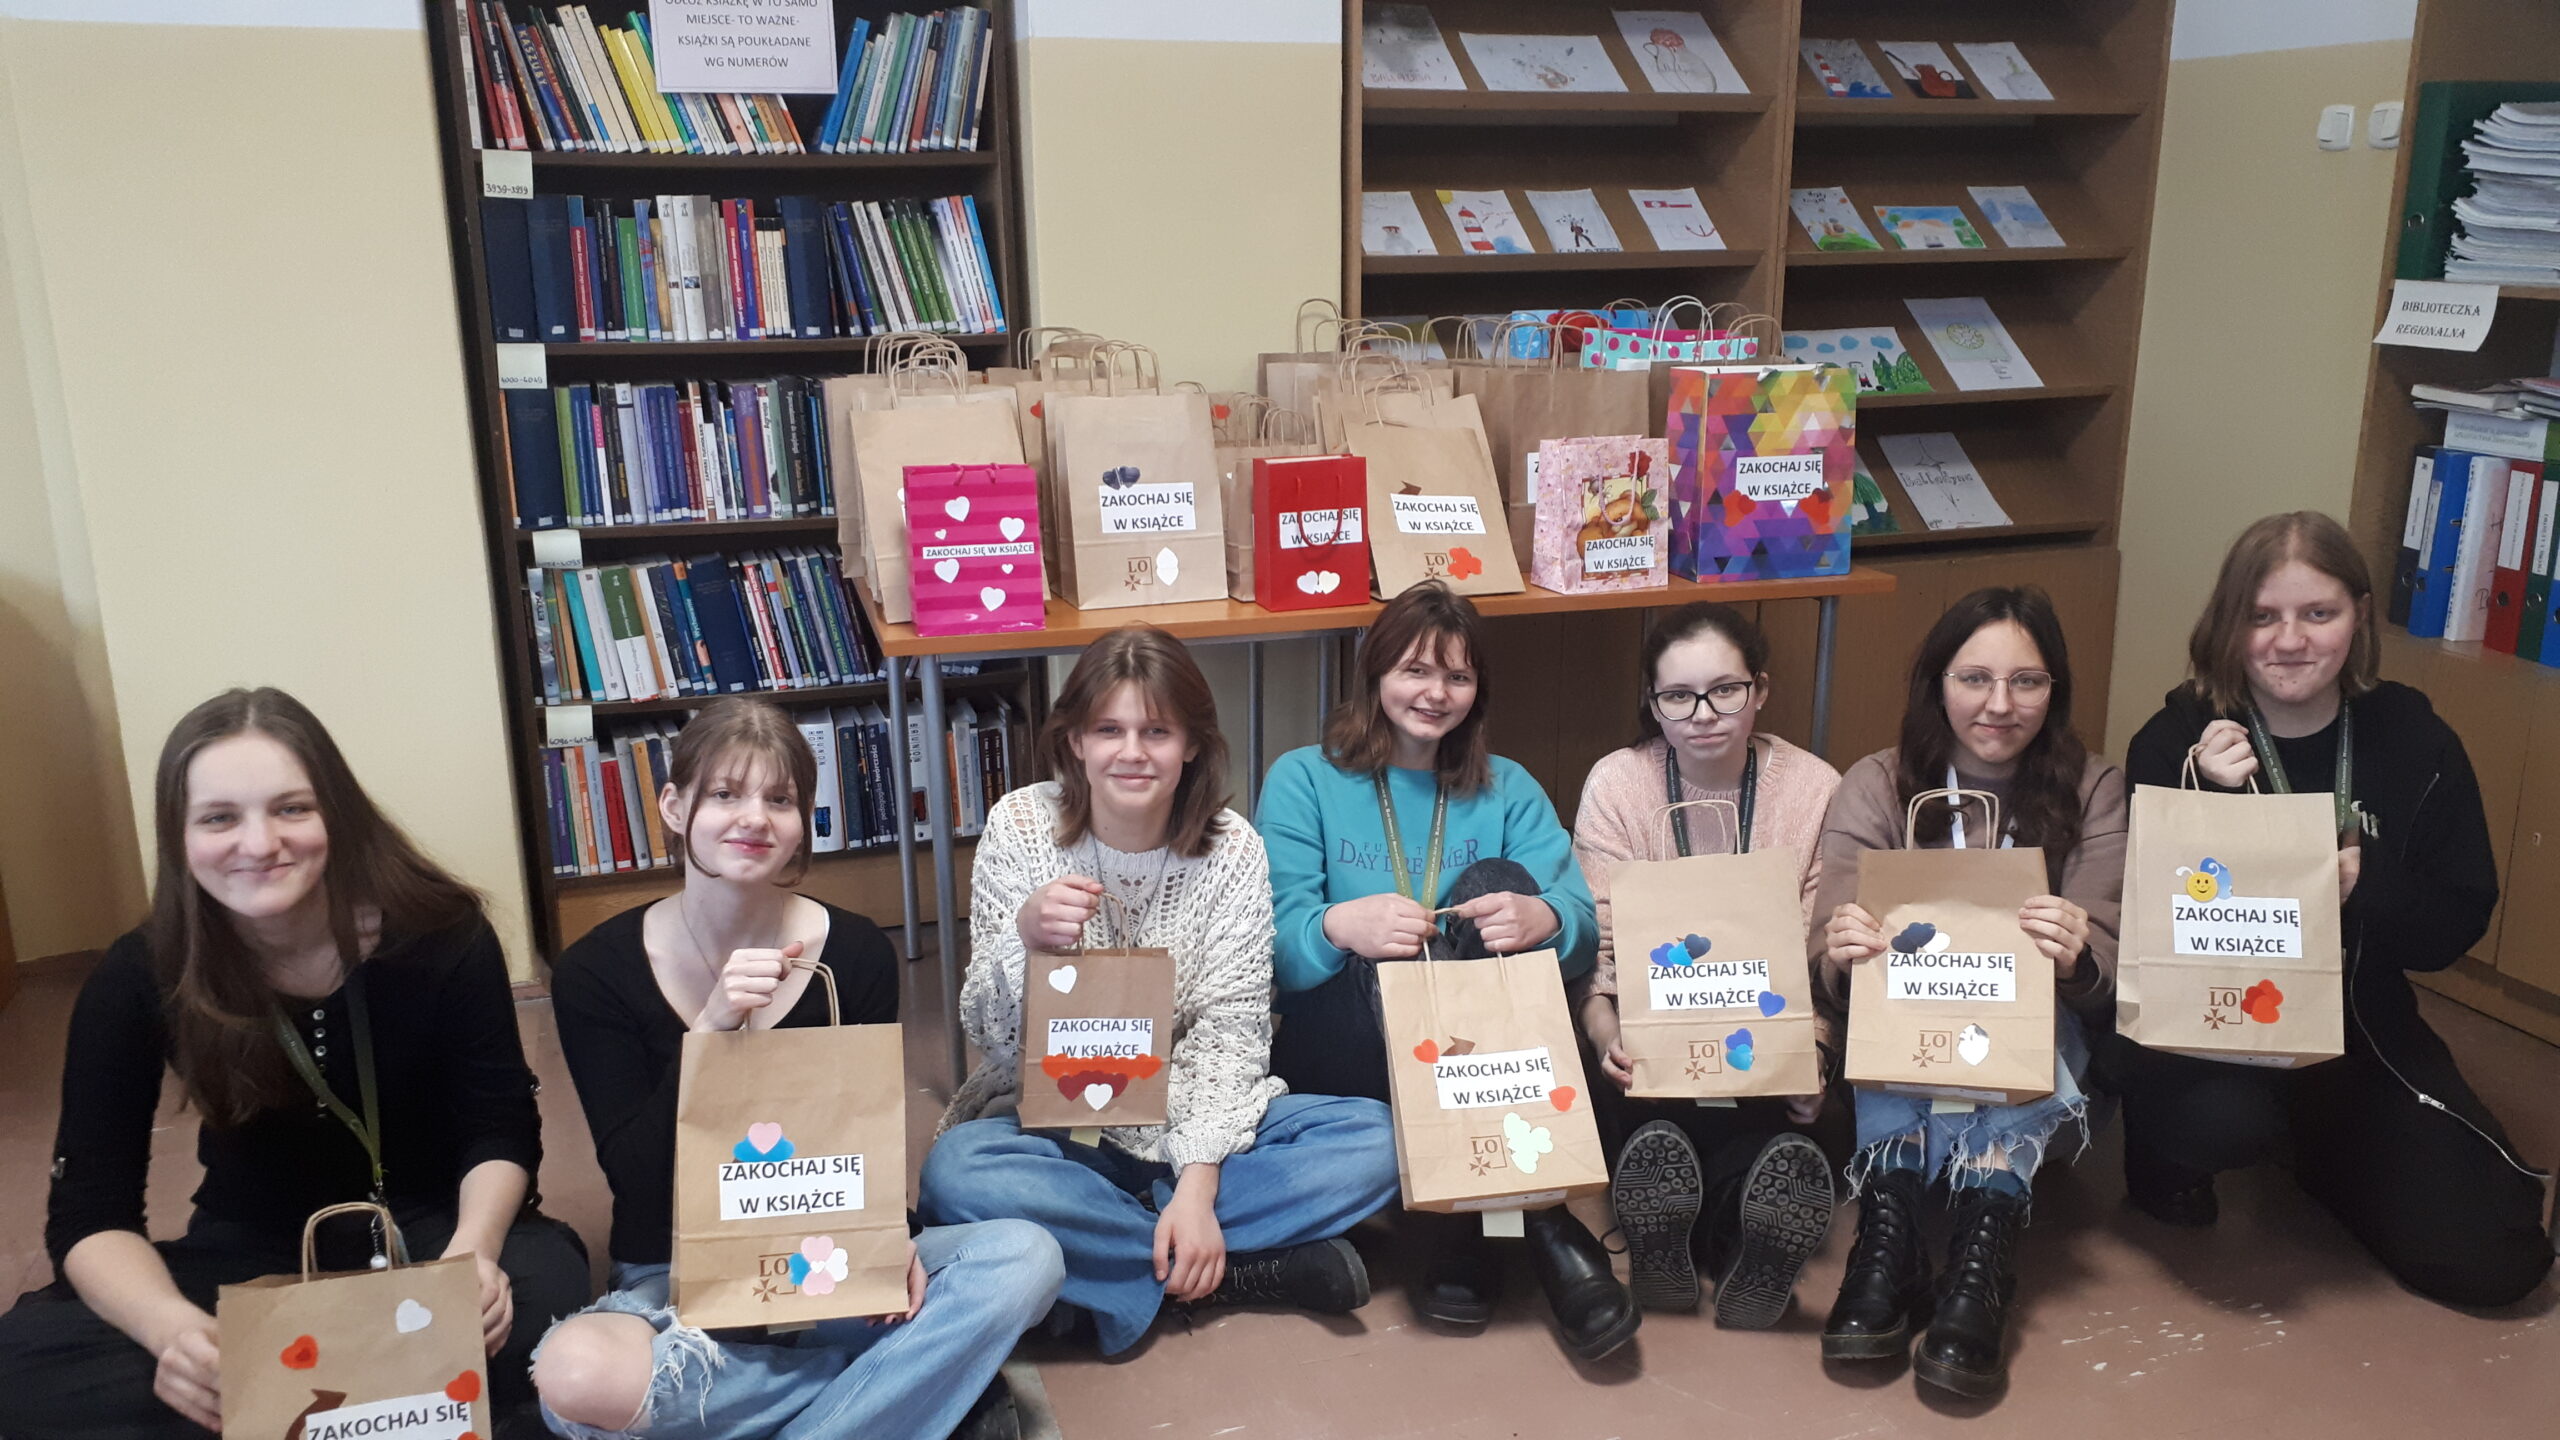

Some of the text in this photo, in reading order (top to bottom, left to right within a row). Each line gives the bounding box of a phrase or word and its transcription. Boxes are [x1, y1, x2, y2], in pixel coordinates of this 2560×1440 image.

[737, 14, 753, 25] TO
[678, 34, 812, 48] KSIĄŻKI SĄ POUKŁADANE
[517, 30, 549, 86] KASZUBY
[704, 55, 789, 68] WG NUMERÓW
[2401, 300, 2481, 317] BIBLIOTECZKA
[2395, 323, 2465, 339] REGIONALNA
[1739, 460, 1821, 474] ZAKOCHAJ SIĘ
[1747, 480, 1811, 498] W KSIĄŻCE
[1101, 491, 1193, 507] ZAKOCHAJ SIĘ
[1394, 501, 1479, 515] ZAKOCHAJ SIĘ
[1114, 513, 1184, 531] W KSIĄŻCE
[1281, 509, 1359, 525] ZAOCHAJ SIĘ
[1408, 519, 1475, 533] W KSIĄŻCE
[926, 543, 1034, 557] ZAKOCHAJ SIĘ W KSIĄŻCE
[1586, 536, 1654, 551] ZAKOCHAJ SIĘ
[1128, 560, 1148, 573] LO
[1425, 555, 1446, 567] LO
[1594, 555, 1646, 570] W KSIĄŻCE
[870, 744, 882, 782] twórczości
[1337, 838, 1378, 870] DAY
[2175, 906, 2299, 927] ZAKOCHAJ SIĘ
[2191, 935, 2286, 956] W KSIĄŻCE
[1650, 960, 1767, 980] ZAKOCHAJ SIĘ
[1890, 954, 2013, 972] ZAKOCHAJ SIĘ
[1666, 987, 1756, 1008] W KSIĄŻCE
[1904, 979, 1999, 999] W KSIĄŻCE
[2209, 992, 2237, 1007] LO
[1051, 1019, 1151, 1034] ZAKOCHAJ SIĘ
[1920, 1033, 1947, 1048] LO
[1062, 1041, 1139, 1058] W KSIĄŻCE
[1689, 1044, 1715, 1059] LO
[1436, 1056, 1551, 1079] ZAKOCHAJ SIĘ
[1453, 1083, 1543, 1106] W KSIĄŻCE
[1472, 1138, 1498, 1156] LO
[722, 1156, 861, 1182] ZAKOCHAJ SIĘ
[739, 1189, 845, 1214] W KSIĄŻCE
[759, 1257, 789, 1278] LO
[309, 1401, 468, 1440] ZAKOCHAJ SIĘ
